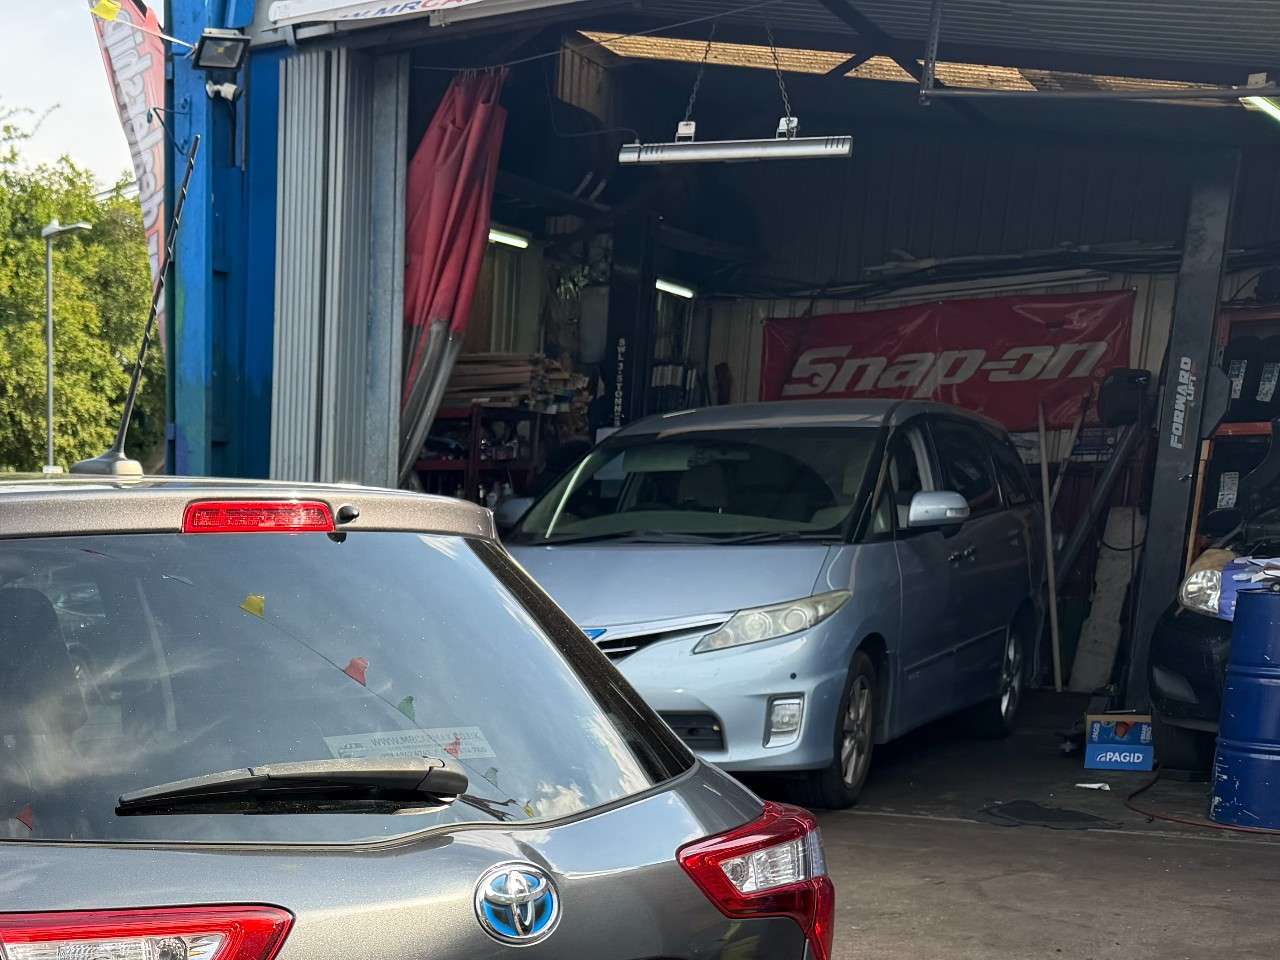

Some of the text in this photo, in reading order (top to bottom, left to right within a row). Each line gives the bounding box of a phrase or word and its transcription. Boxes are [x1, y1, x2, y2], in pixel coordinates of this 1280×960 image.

[782, 341, 1108, 398] Snap-on
[1170, 356, 1192, 449] FORWARD
[1106, 751, 1144, 763] PAGID
